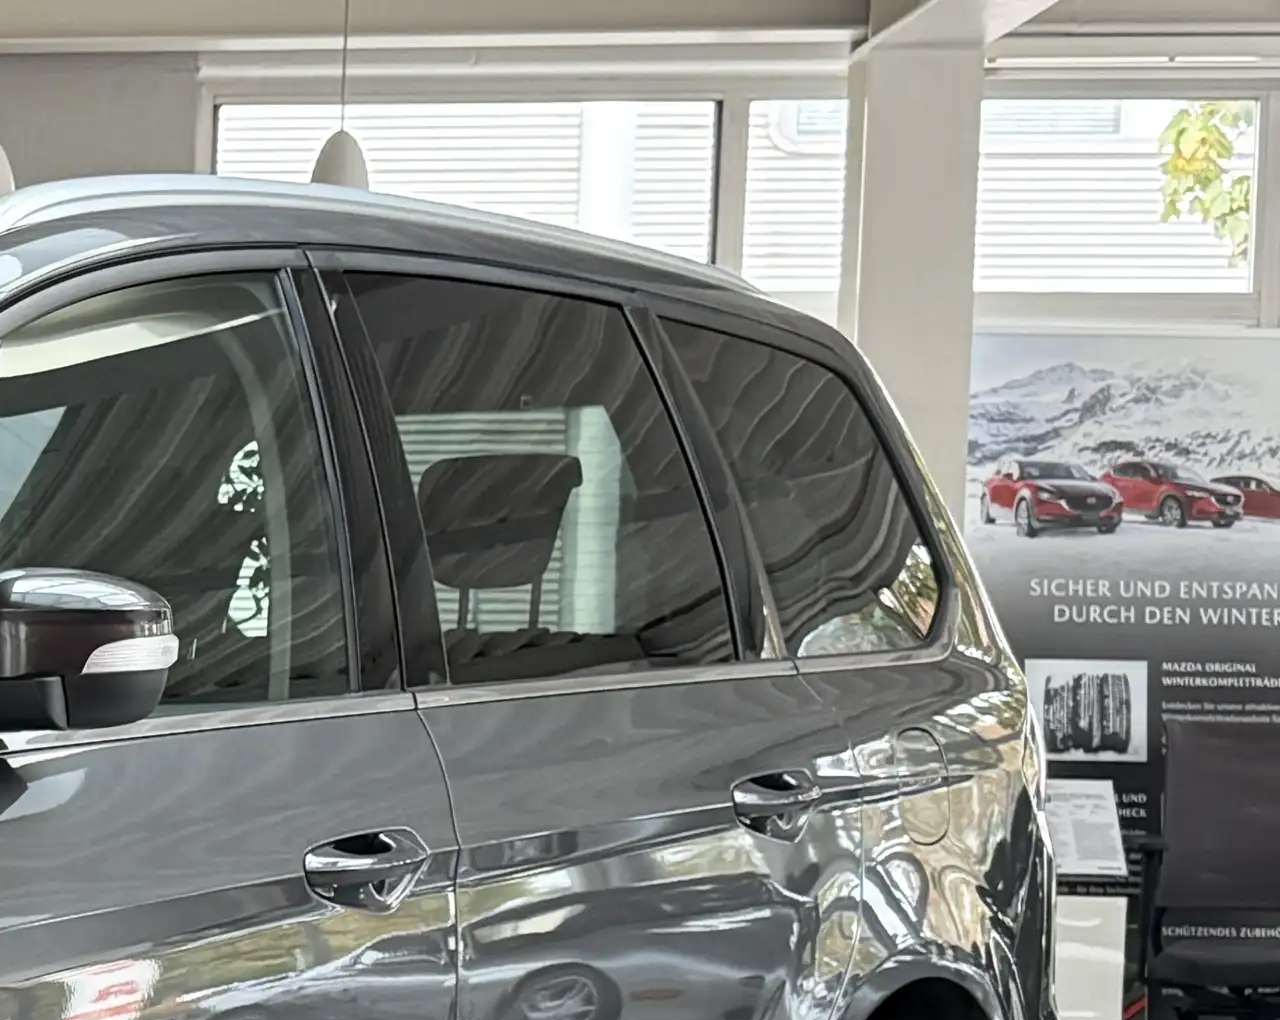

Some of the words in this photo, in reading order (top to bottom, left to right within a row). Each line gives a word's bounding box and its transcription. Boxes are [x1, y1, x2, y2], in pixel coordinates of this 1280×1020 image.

[1029, 578, 1111, 598] SICHER
[1119, 580, 1171, 598] UND
[1180, 581, 1279, 600] ENTSPAN
[1053, 605, 1135, 624] DURCH
[1145, 606, 1191, 625] DEN
[1200, 607, 1280, 627] WINTER
[1161, 661, 1203, 673] MAZDA
[1205, 662, 1256, 674] ORIGINAL
[1122, 792, 1147, 804] UND
